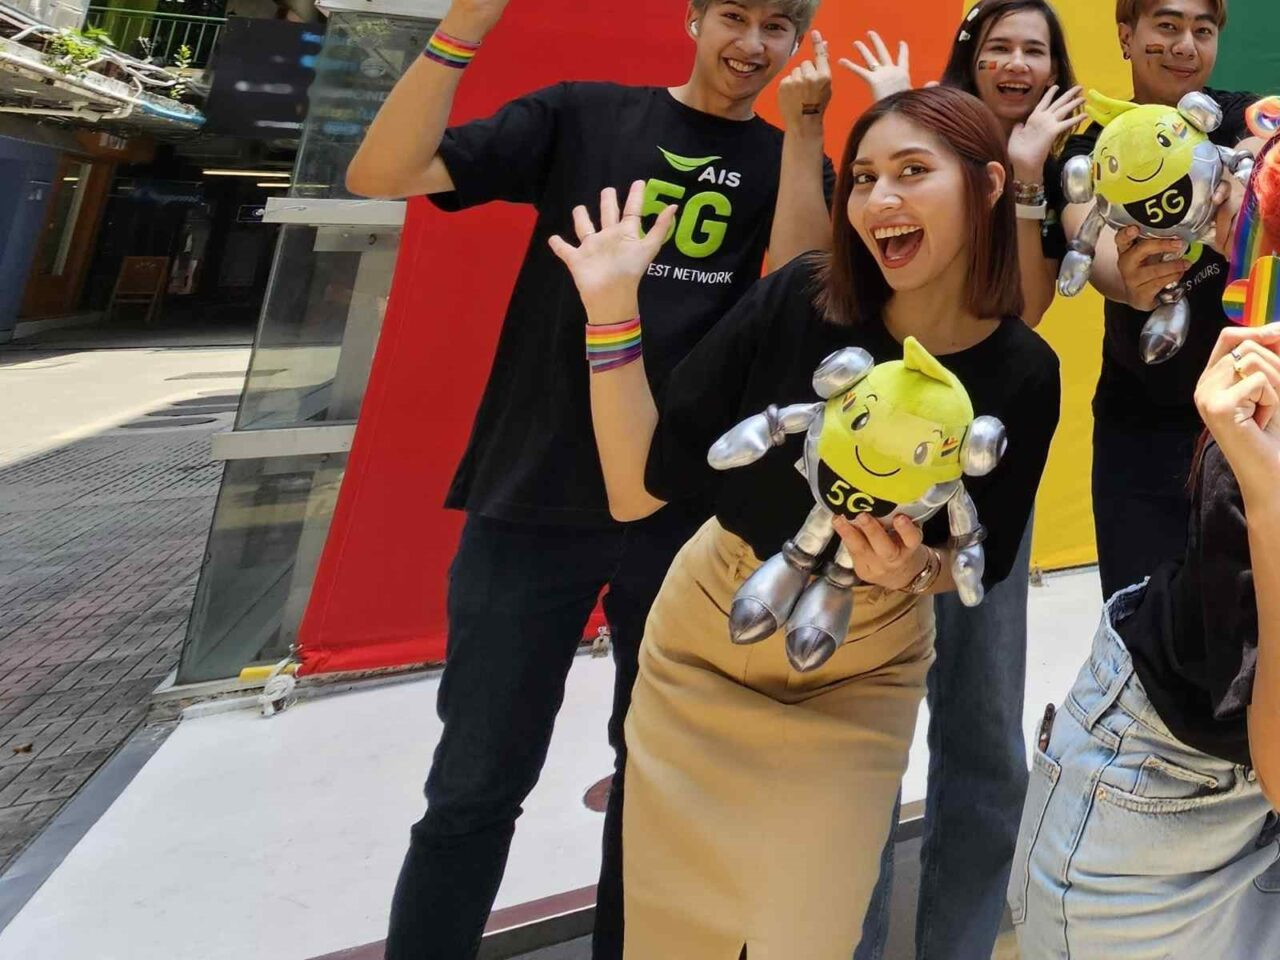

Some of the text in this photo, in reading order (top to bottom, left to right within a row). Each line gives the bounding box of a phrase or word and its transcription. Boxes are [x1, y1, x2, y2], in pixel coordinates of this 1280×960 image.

[697, 166, 743, 188] AIS
[638, 178, 733, 259] 5G
[1143, 188, 1186, 224] 5G
[672, 267, 734, 285] NETWORK
[825, 479, 876, 514] 5G
